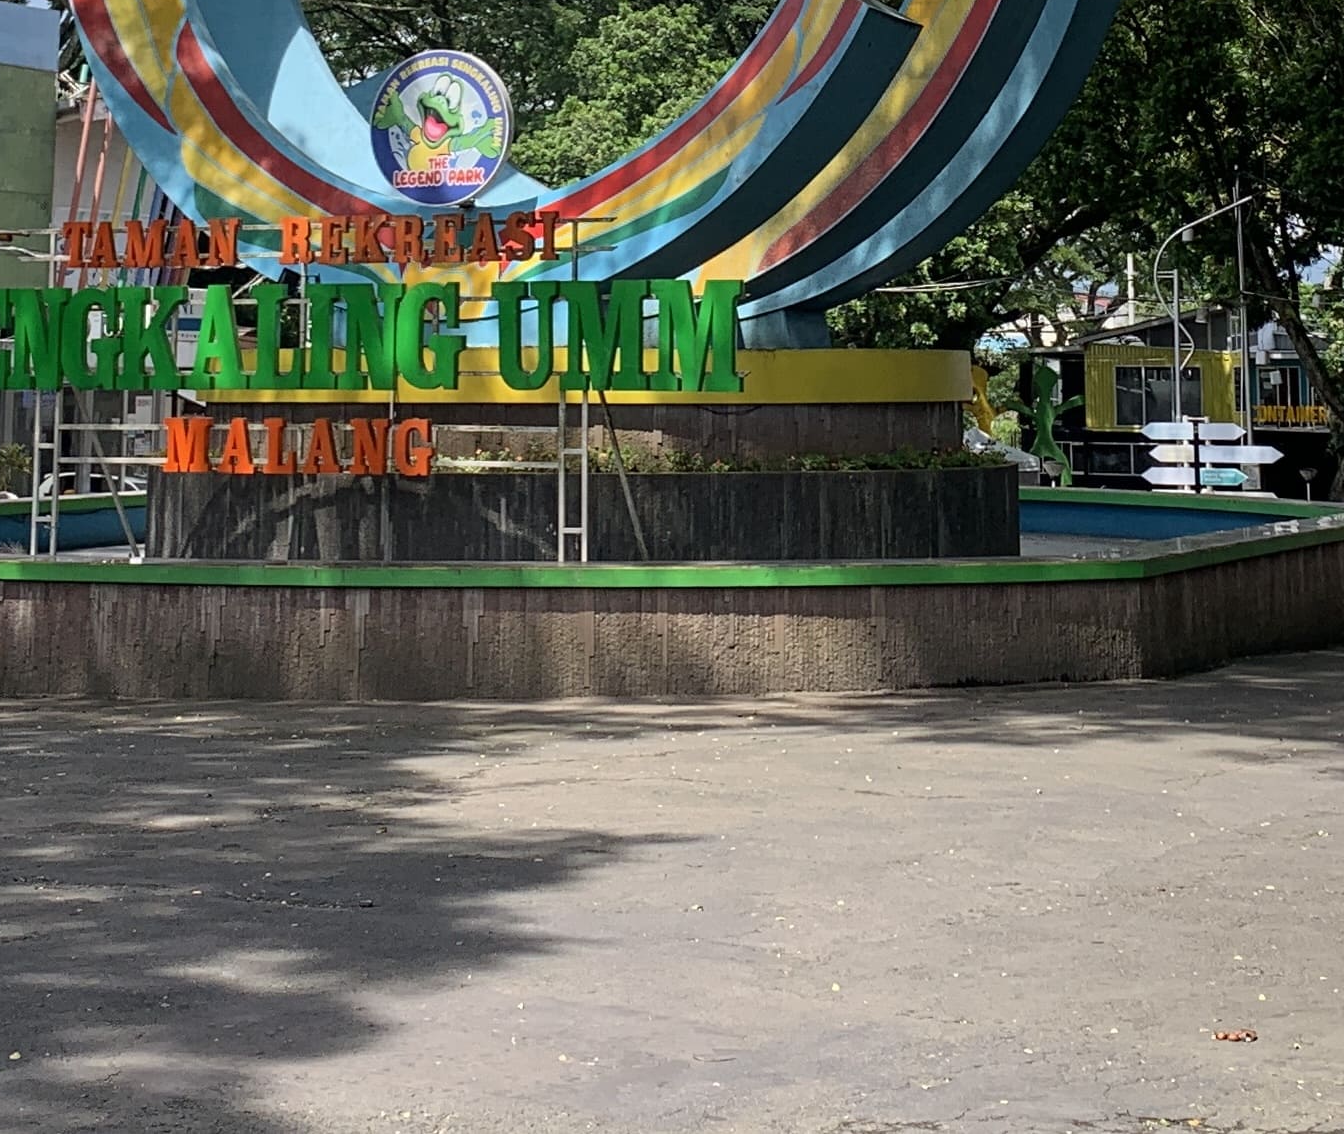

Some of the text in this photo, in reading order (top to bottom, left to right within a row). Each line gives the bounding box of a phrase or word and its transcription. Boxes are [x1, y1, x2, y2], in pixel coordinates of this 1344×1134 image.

[374, 79, 401, 119] TAMAN
[400, 56, 449, 79] REKREASI
[451, 59, 502, 114] SENGKALING
[394, 169, 484, 187] LEGEND PARK
[428, 158, 450, 169] THE
[63, 210, 560, 268] TAMAN REKREASI
[492, 280, 744, 392] UMM
[162, 417, 435, 476] MALANG
